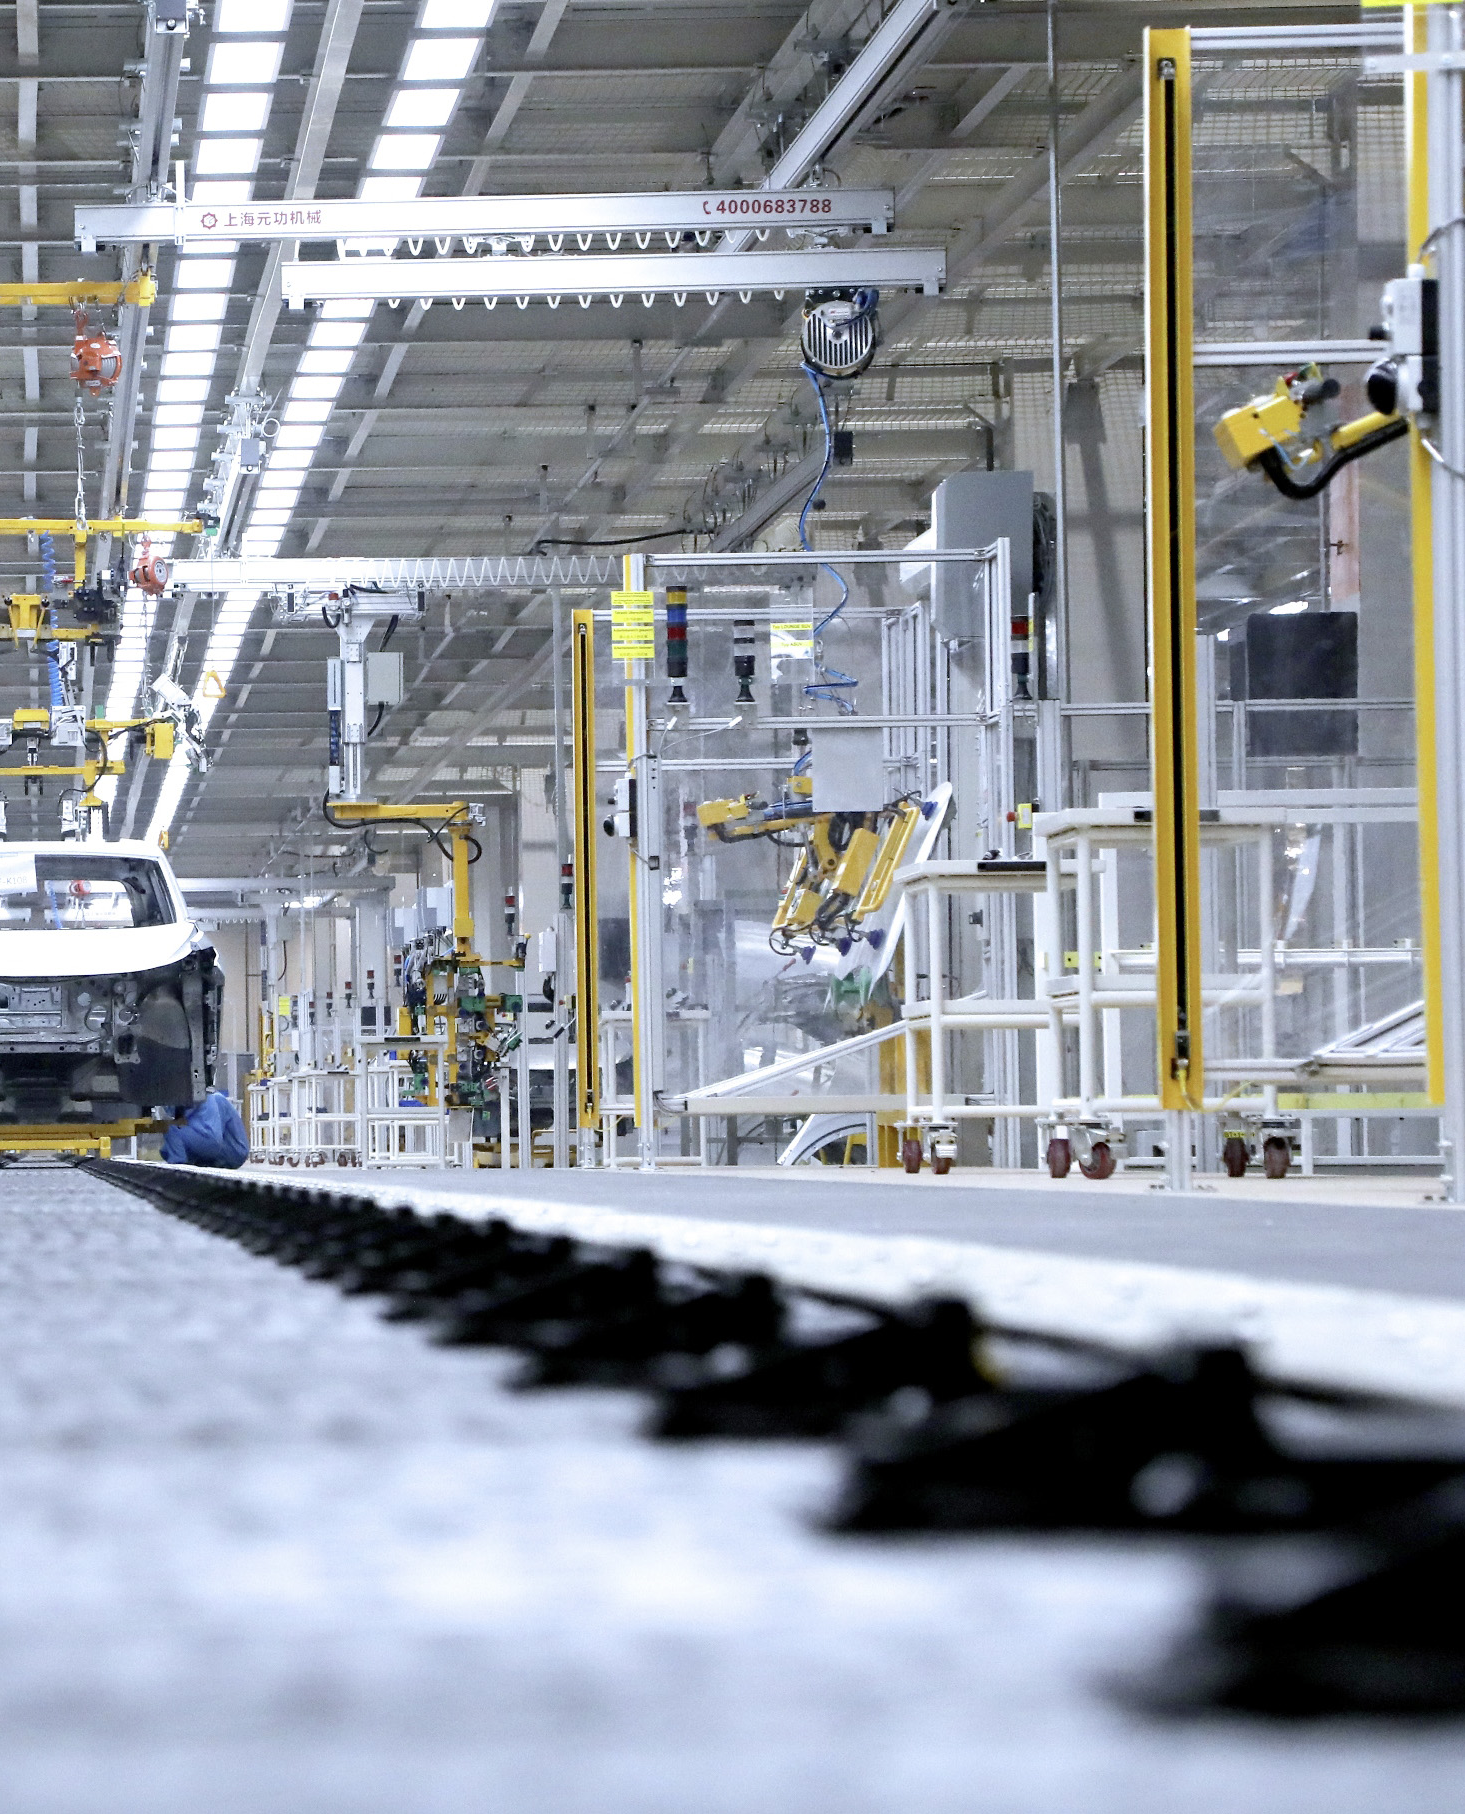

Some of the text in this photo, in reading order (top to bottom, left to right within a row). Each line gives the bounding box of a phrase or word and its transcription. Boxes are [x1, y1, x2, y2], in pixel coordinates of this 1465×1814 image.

[716, 199, 833, 214] 4000683788
[224, 209, 322, 227] 上海元功机械
